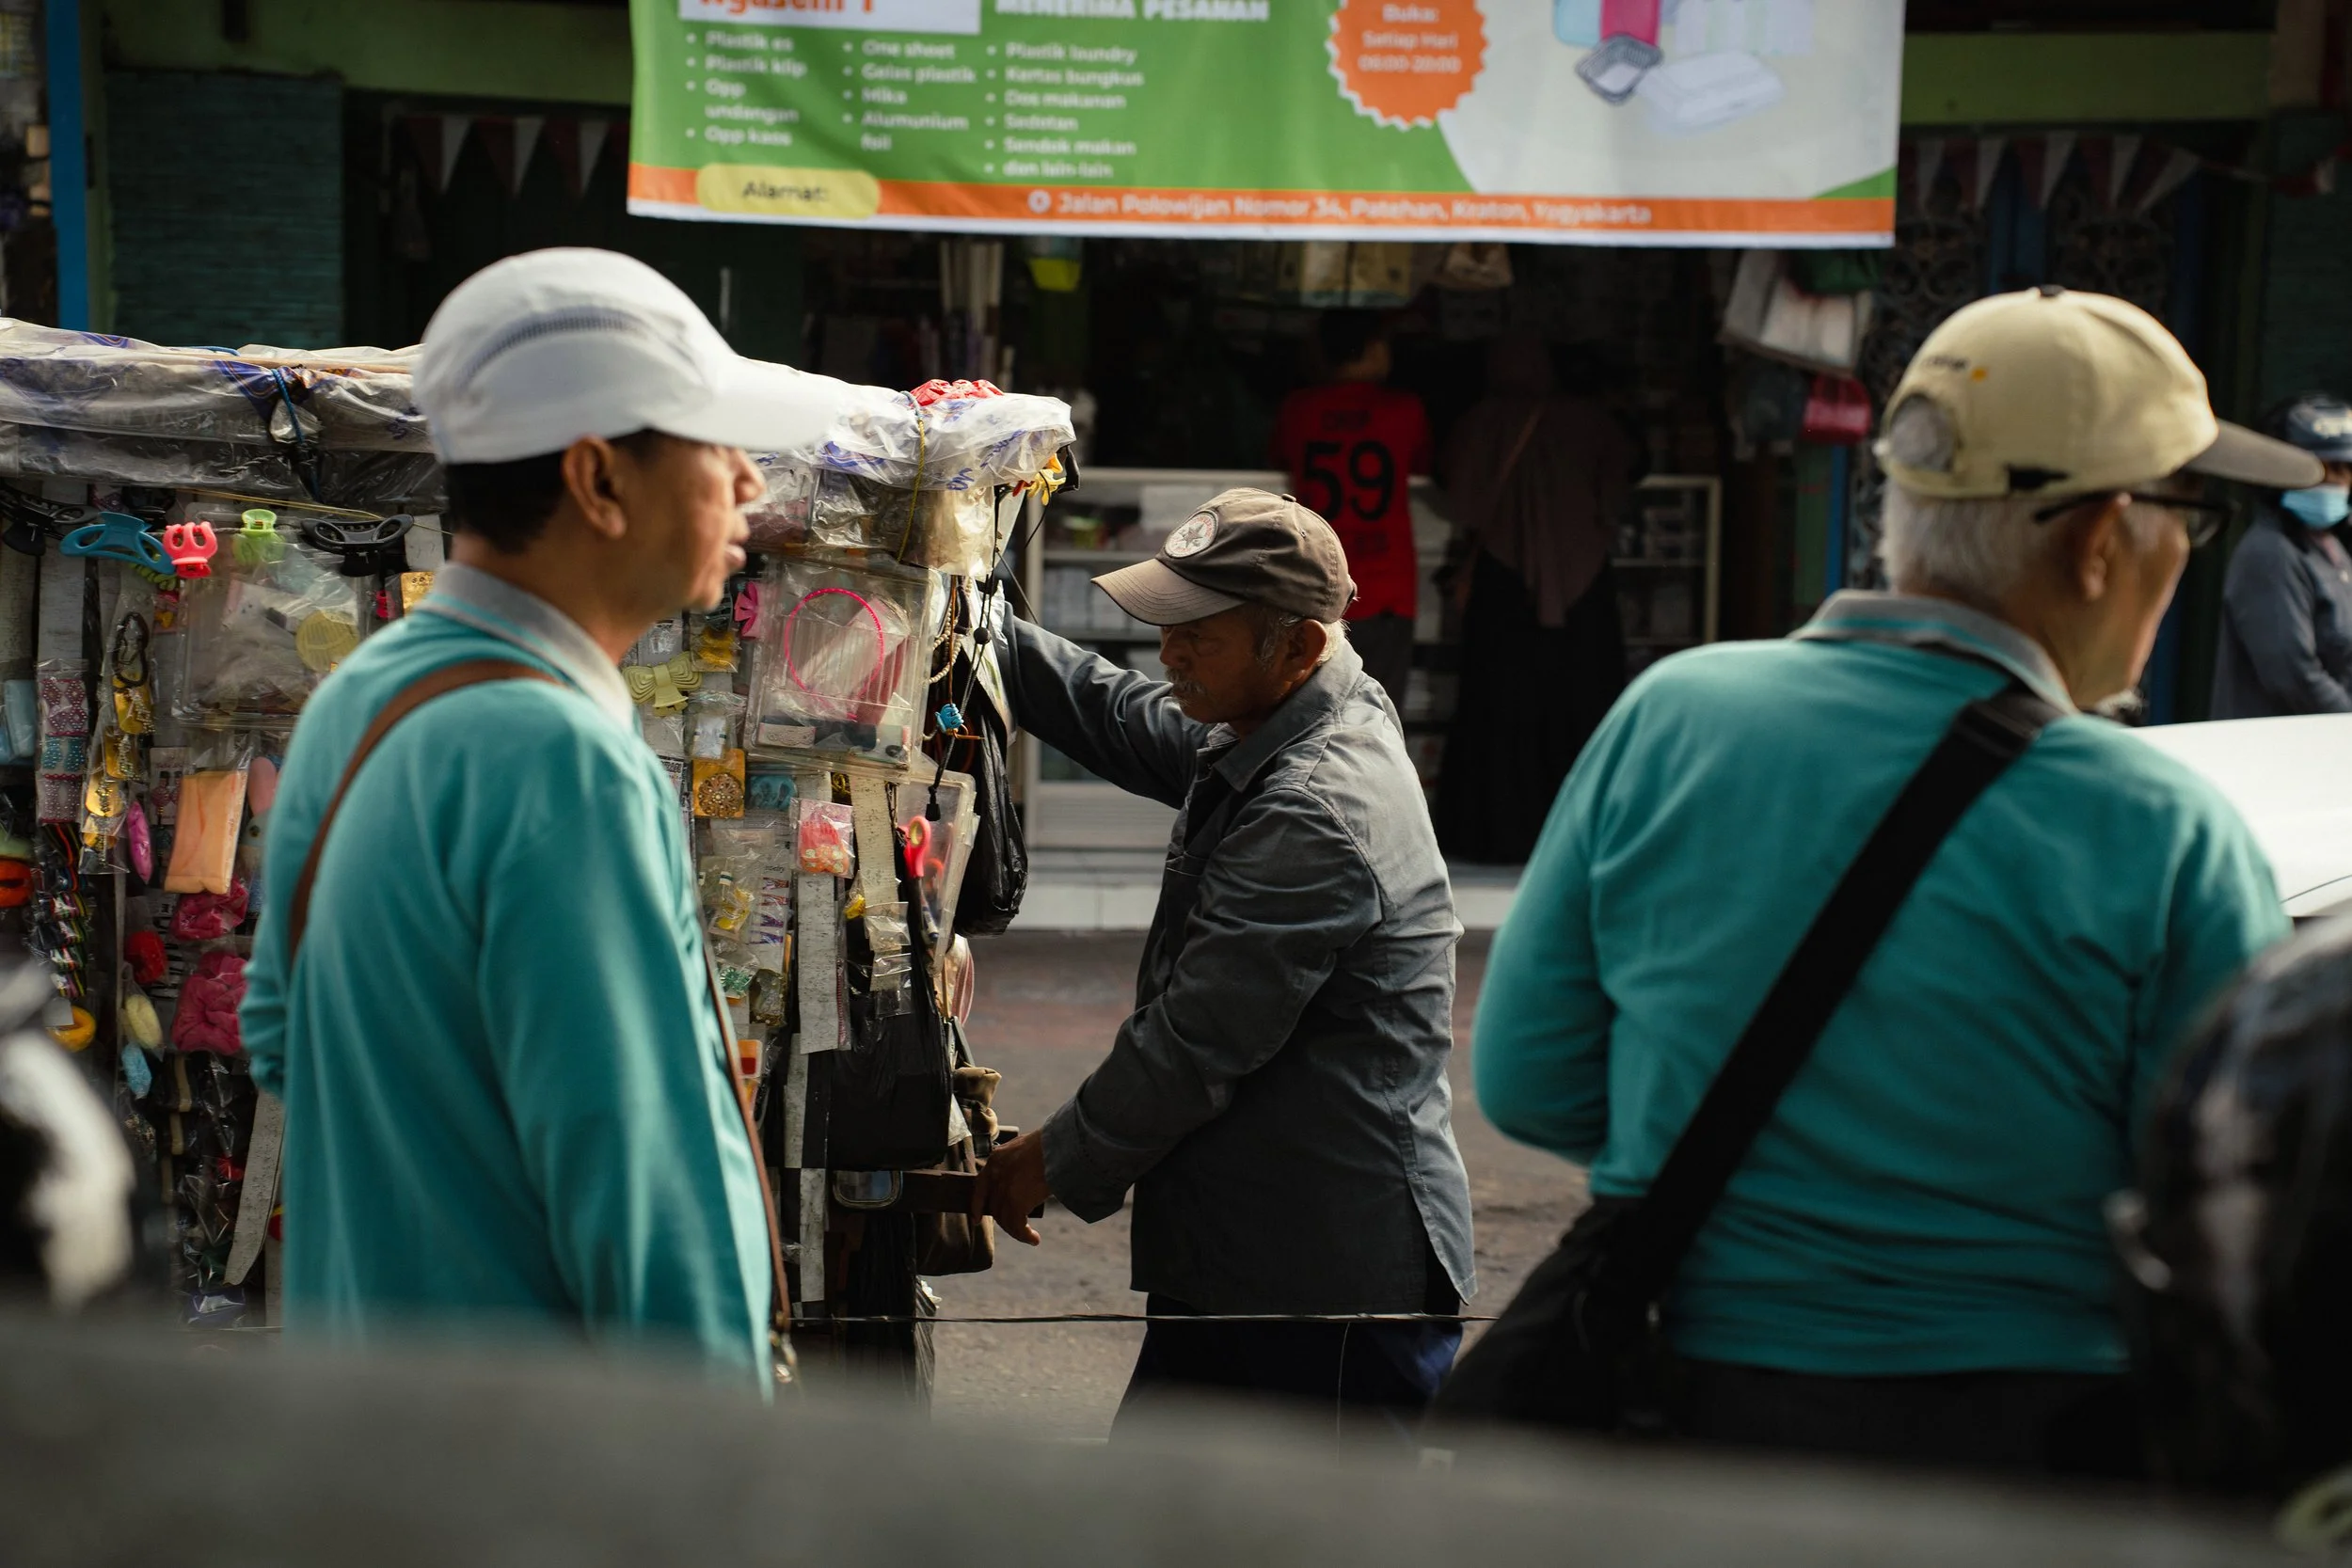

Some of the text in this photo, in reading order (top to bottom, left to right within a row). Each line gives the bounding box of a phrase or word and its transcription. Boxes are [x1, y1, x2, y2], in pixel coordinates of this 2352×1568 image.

[700, 0, 844, 15] gasem
[705, 31, 768, 50] Plastik
[862, 40, 904, 58] One
[1362, 30, 1459, 52] Setiap Hari
[1005, 40, 1137, 67] Plastik laundry
[705, 55, 809, 79] Plastik klip
[915, 66, 978, 86] plastik
[1005, 65, 1145, 90] Kertas bungkus
[705, 78, 747, 100] Opp
[862, 87, 910, 105] Mika
[1004, 87, 1128, 110] Dos makanan
[704, 104, 801, 126] undangan
[861, 110, 971, 131] Alumunium
[1004, 111, 1079, 130] Sedotan
[704, 125, 746, 146] Opp
[1003, 135, 1137, 156] Sendok makan
[1002, 160, 1039, 178] dan
[1057, 191, 1119, 214] Jalan
[1233, 196, 1311, 216] Nomor
[1452, 198, 1531, 222] Kraton,
[1532, 200, 1652, 224] Yogyakarta
[1303, 441, 1394, 521] 59
